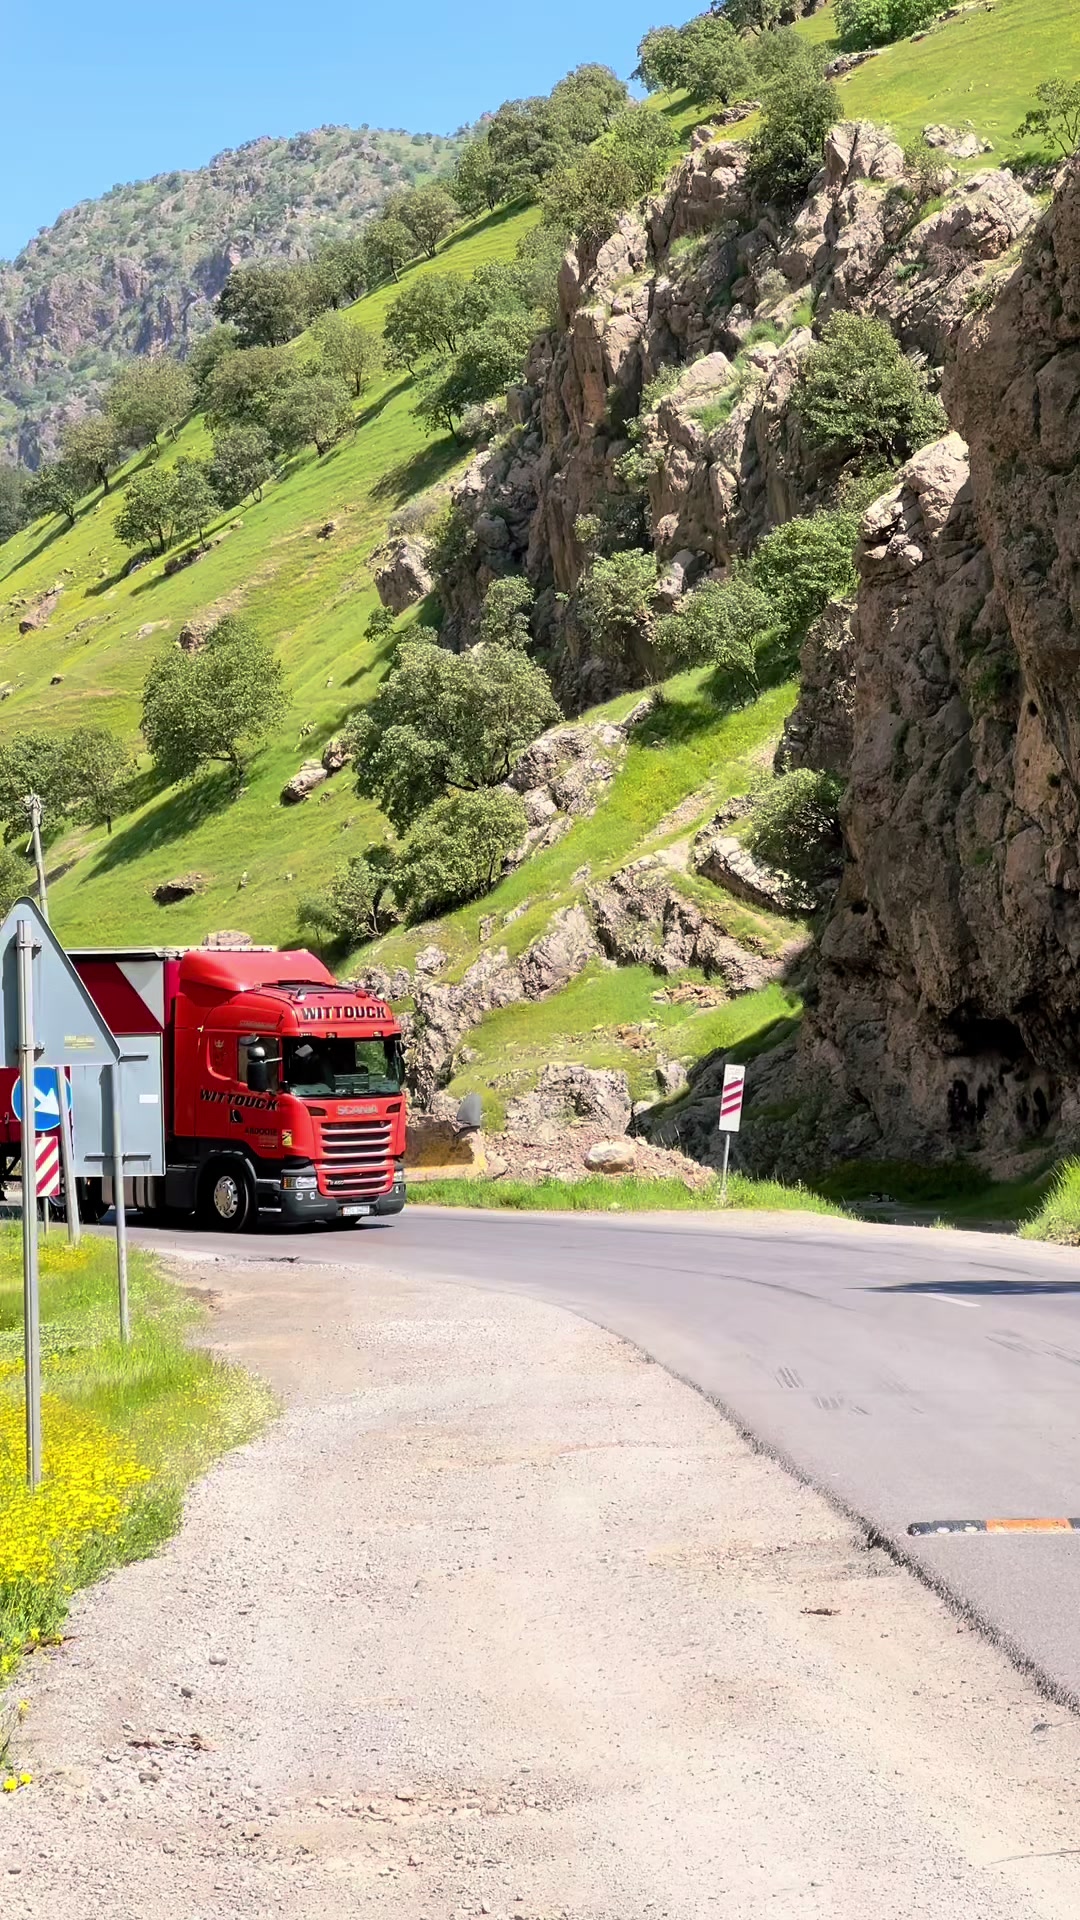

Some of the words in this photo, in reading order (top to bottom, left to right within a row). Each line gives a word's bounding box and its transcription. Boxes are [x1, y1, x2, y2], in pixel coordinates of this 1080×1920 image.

[301, 1006, 386, 1020] WITTOUCK
[201, 1089, 278, 1111] WITTOUCK
[337, 1105, 378, 1115] SCANIA
